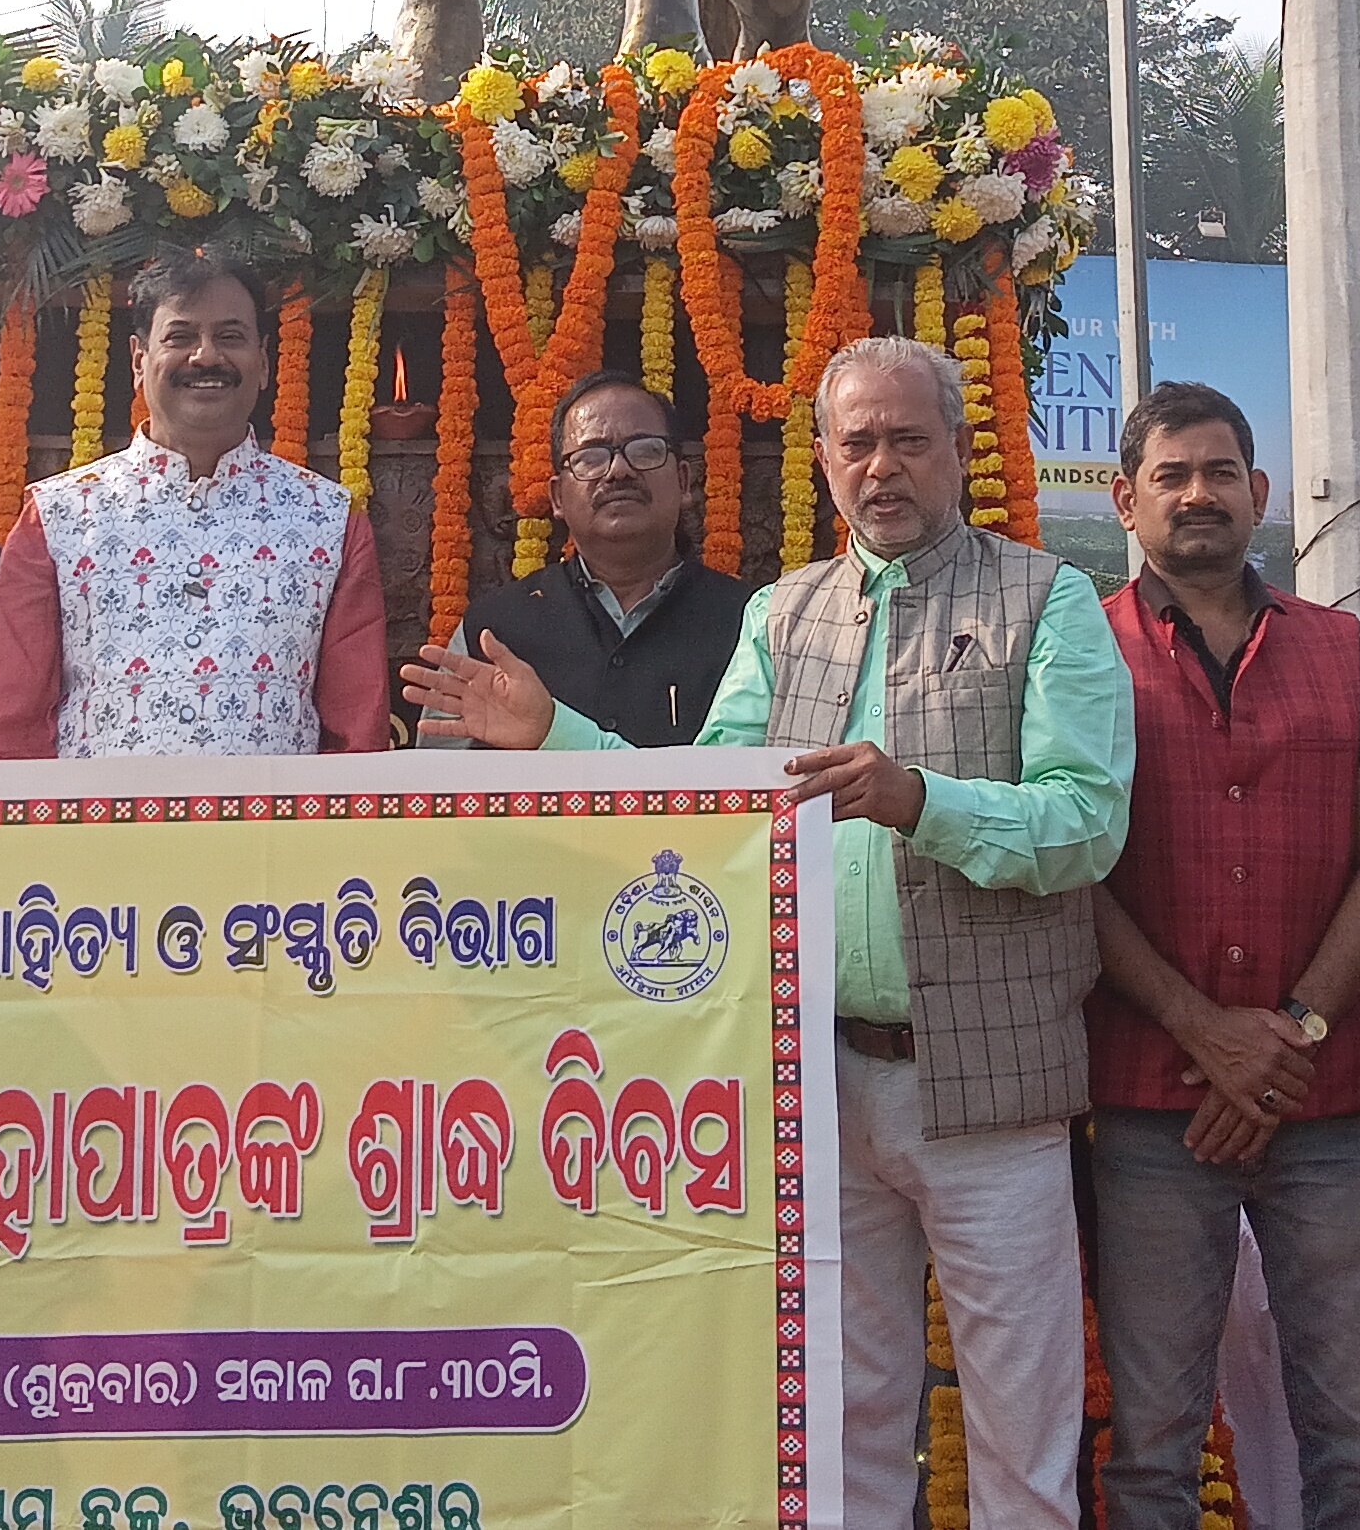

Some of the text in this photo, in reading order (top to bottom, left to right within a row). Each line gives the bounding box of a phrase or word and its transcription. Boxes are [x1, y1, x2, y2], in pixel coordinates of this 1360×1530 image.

[157, 905, 204, 971] ଓ
[224, 878, 378, 992] ସଂସ୍କୃତି
[400, 876, 554, 968] ବିଭାଗ
[348, 1078, 512, 1238] ଶ୍ରାଦ୍ଧ
[540, 1028, 743, 1212] ଦିବସ
[3, 1360, 198, 1419] (ଶୁକ୍ରବାର)
[215, 1359, 332, 1401] ସକାଳ
